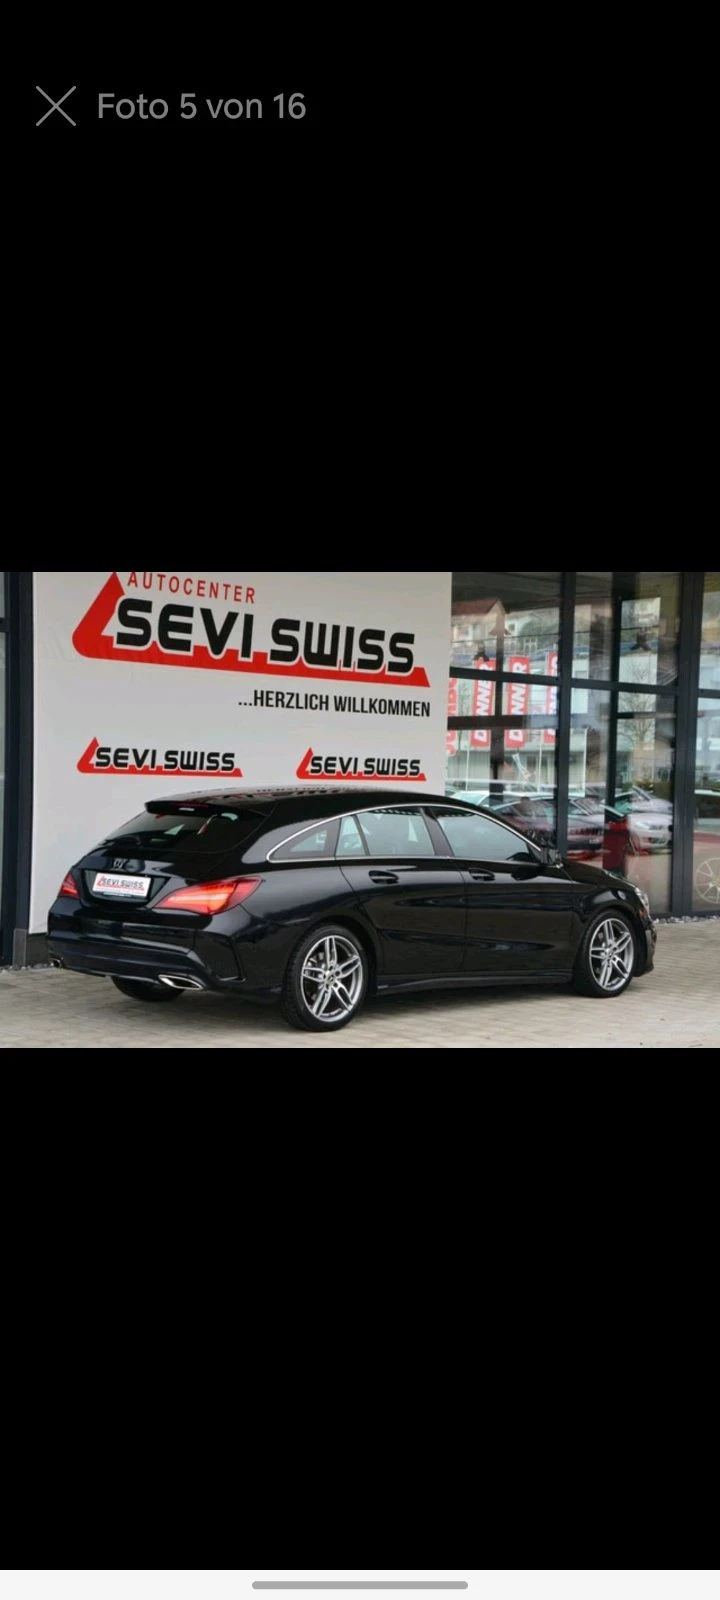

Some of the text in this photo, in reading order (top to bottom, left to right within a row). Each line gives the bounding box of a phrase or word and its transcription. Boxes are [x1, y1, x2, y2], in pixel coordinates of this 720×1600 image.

[127, 572, 256, 604] AUTOCENTER
[116, 597, 416, 674] SEVI SWISS
[238, 689, 431, 717] ...HERZLICH WILLKOMMEN
[95, 747, 235, 771] SEVI SWISS
[310, 756, 421, 776] SEVI SWISS
